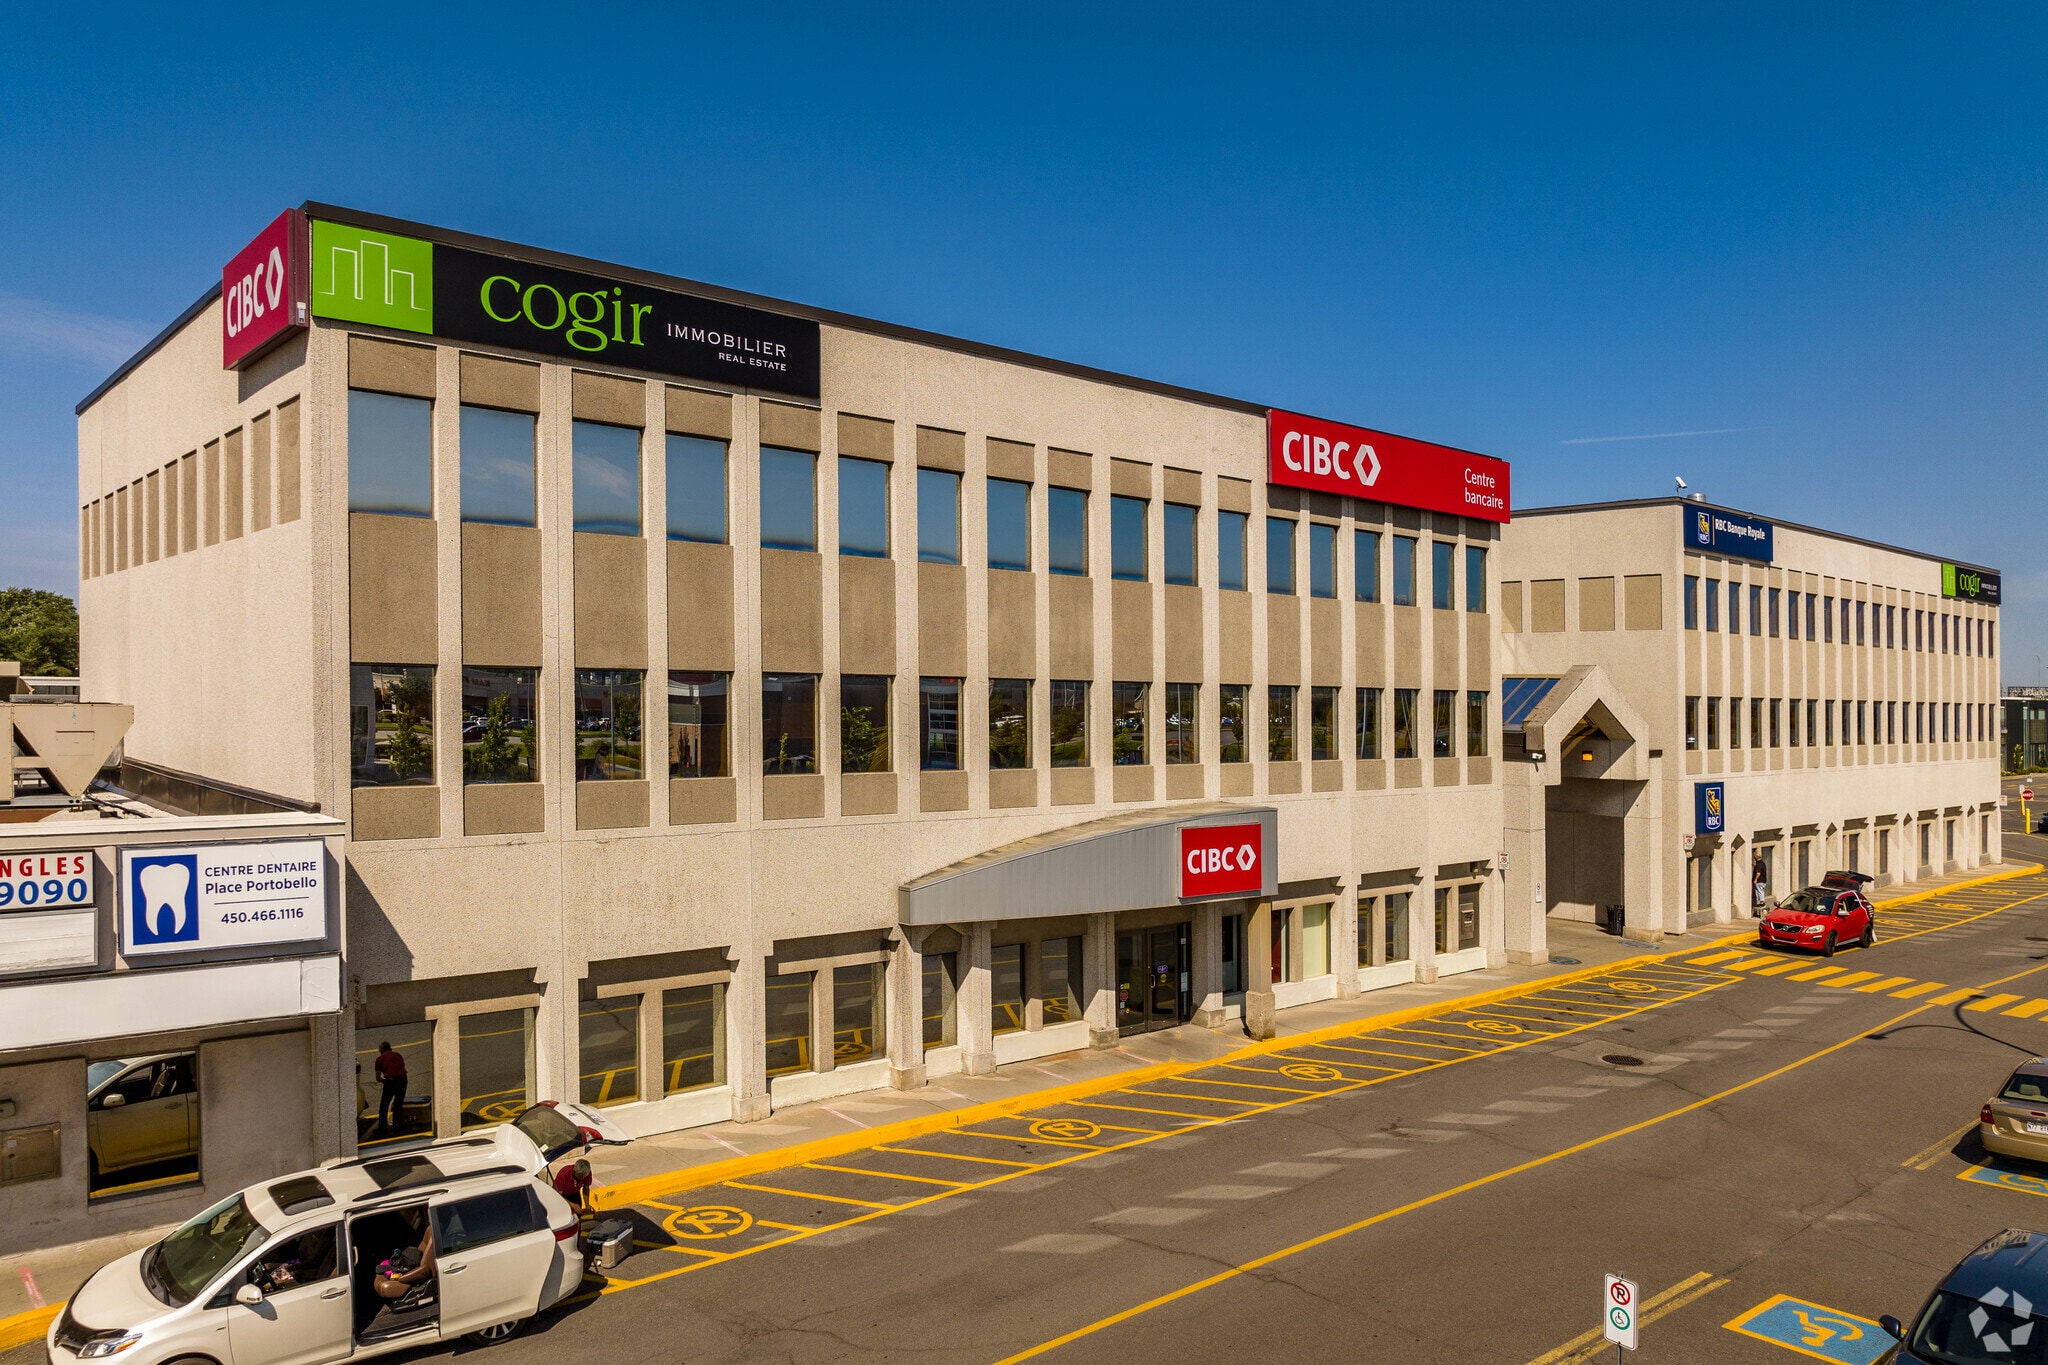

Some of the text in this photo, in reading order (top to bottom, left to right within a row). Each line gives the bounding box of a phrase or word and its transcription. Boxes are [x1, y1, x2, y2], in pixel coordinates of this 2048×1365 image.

[226, 262, 265, 338] CIBC
[480, 275, 653, 352] cogir
[667, 323, 786, 358] IMMOBILIER
[718, 352, 787, 372] REAL ESTATE
[1282, 431, 1351, 480] CIBC
[1464, 468, 1495, 489] Centre
[1464, 487, 1504, 510] bancaire
[1715, 518, 1766, 541] RBC Banque Royale
[1959, 572, 1981, 597] cogir
[1707, 815, 1720, 826] RBC
[204, 861, 317, 877] CENTRE DENTAIRE
[1187, 847, 1235, 875] CIBC
[0, 878, 88, 906] 9090
[205, 877, 317, 894] Place Portobello
[221, 908, 304, 924] 450.466.1116
